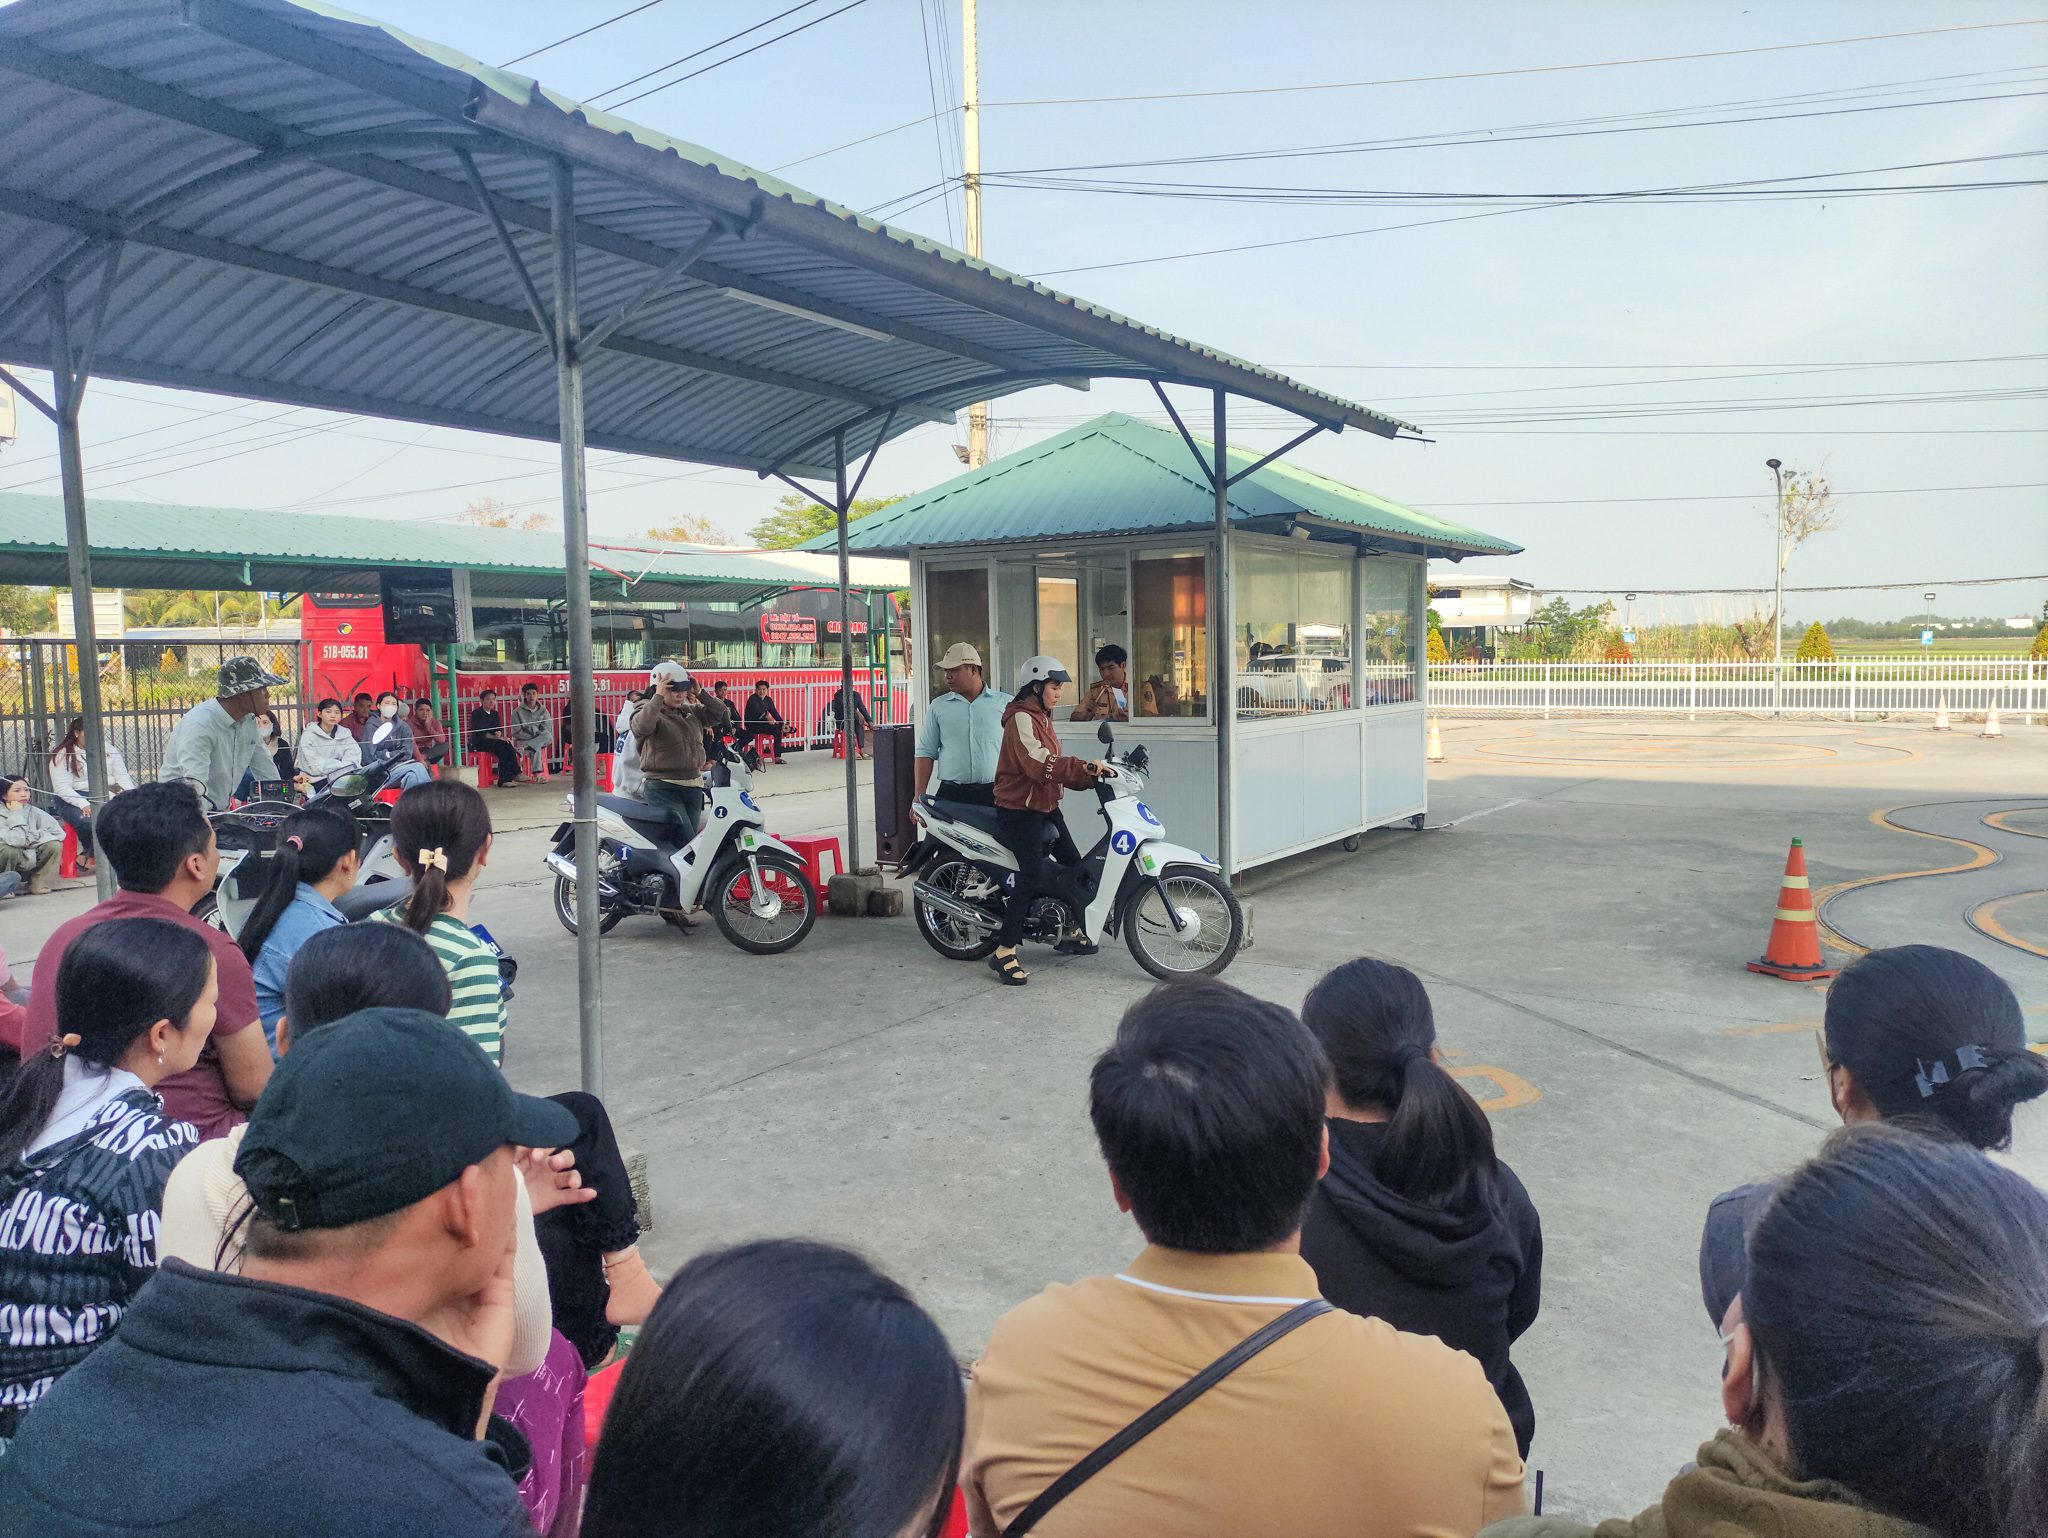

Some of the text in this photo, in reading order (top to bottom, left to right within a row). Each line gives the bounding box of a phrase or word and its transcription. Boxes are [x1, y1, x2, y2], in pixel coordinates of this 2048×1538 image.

[323, 645, 369, 660] 51B-055.81
[559, 679, 610, 691] 515.81
[1144, 806, 1158, 822] 4
[1116, 834, 1130, 853] 4
[620, 846, 628, 860] 1
[1006, 872, 1016, 888] 4
